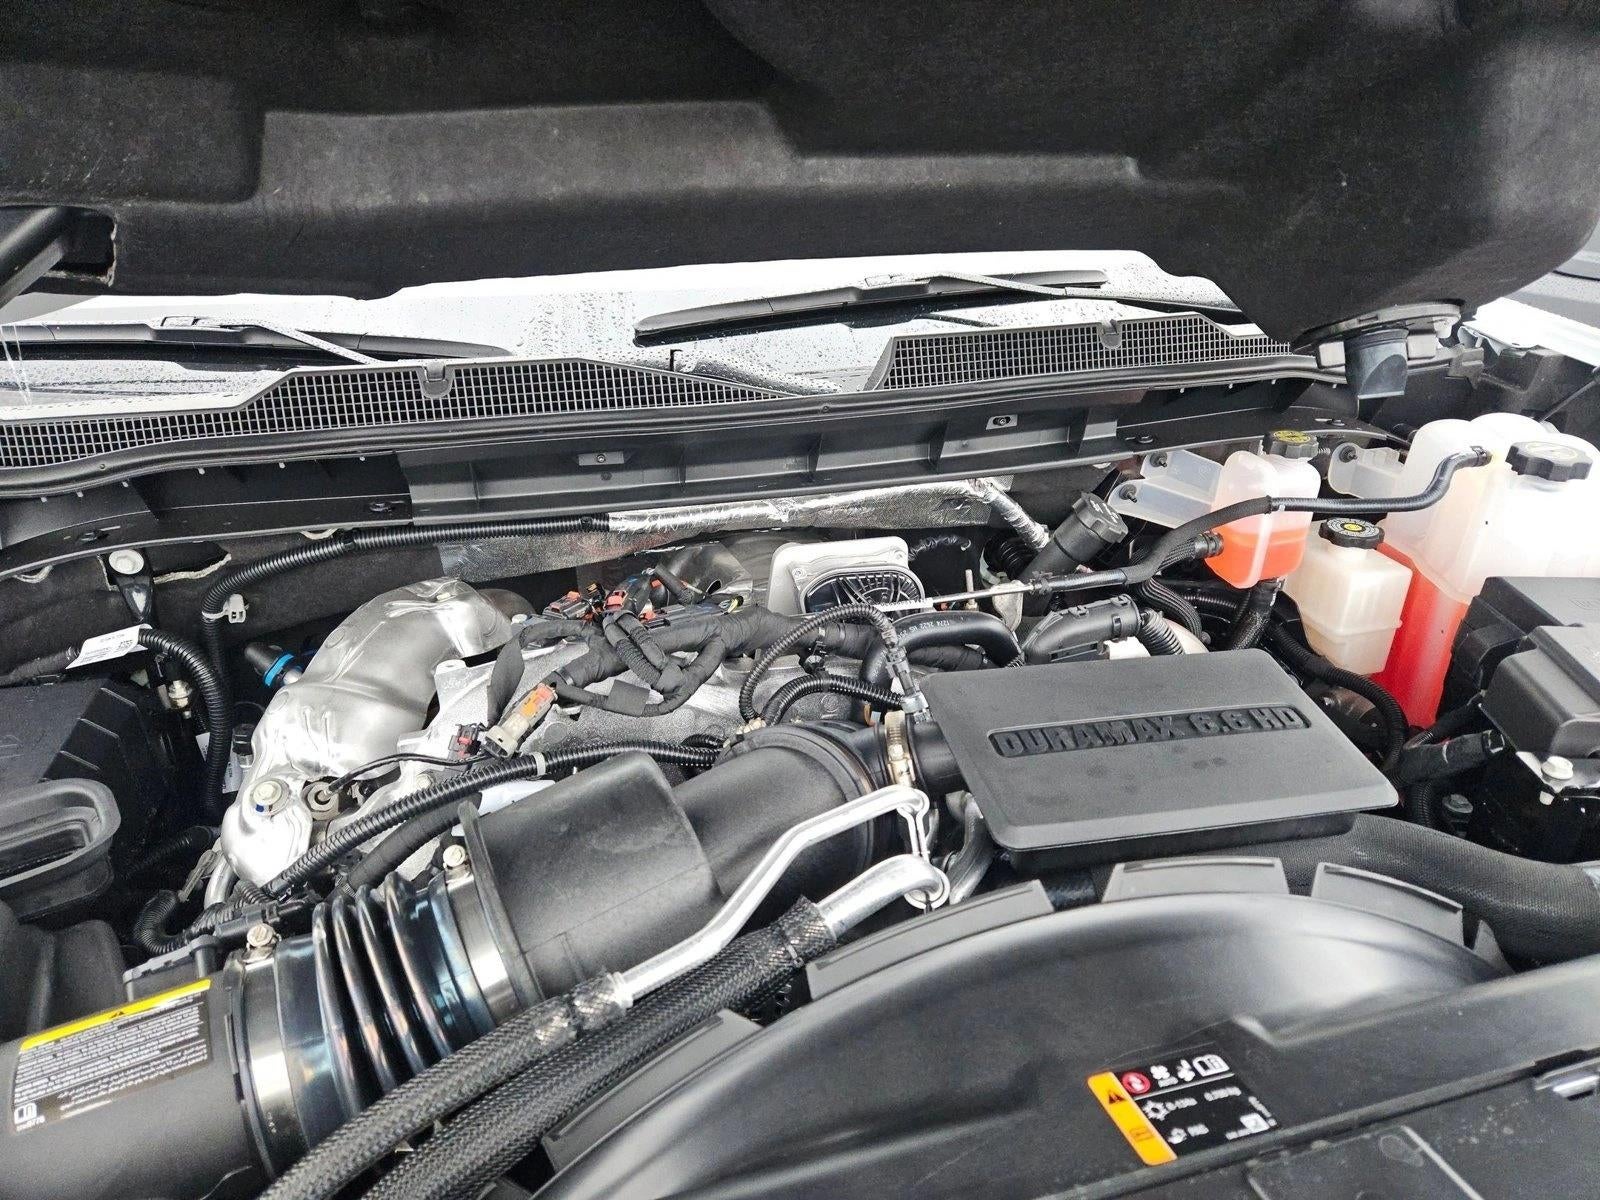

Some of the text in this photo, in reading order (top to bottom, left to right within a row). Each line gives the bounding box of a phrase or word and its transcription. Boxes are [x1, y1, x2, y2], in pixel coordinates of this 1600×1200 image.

[994, 706, 1304, 757] DURAMAX 6.6 HD
